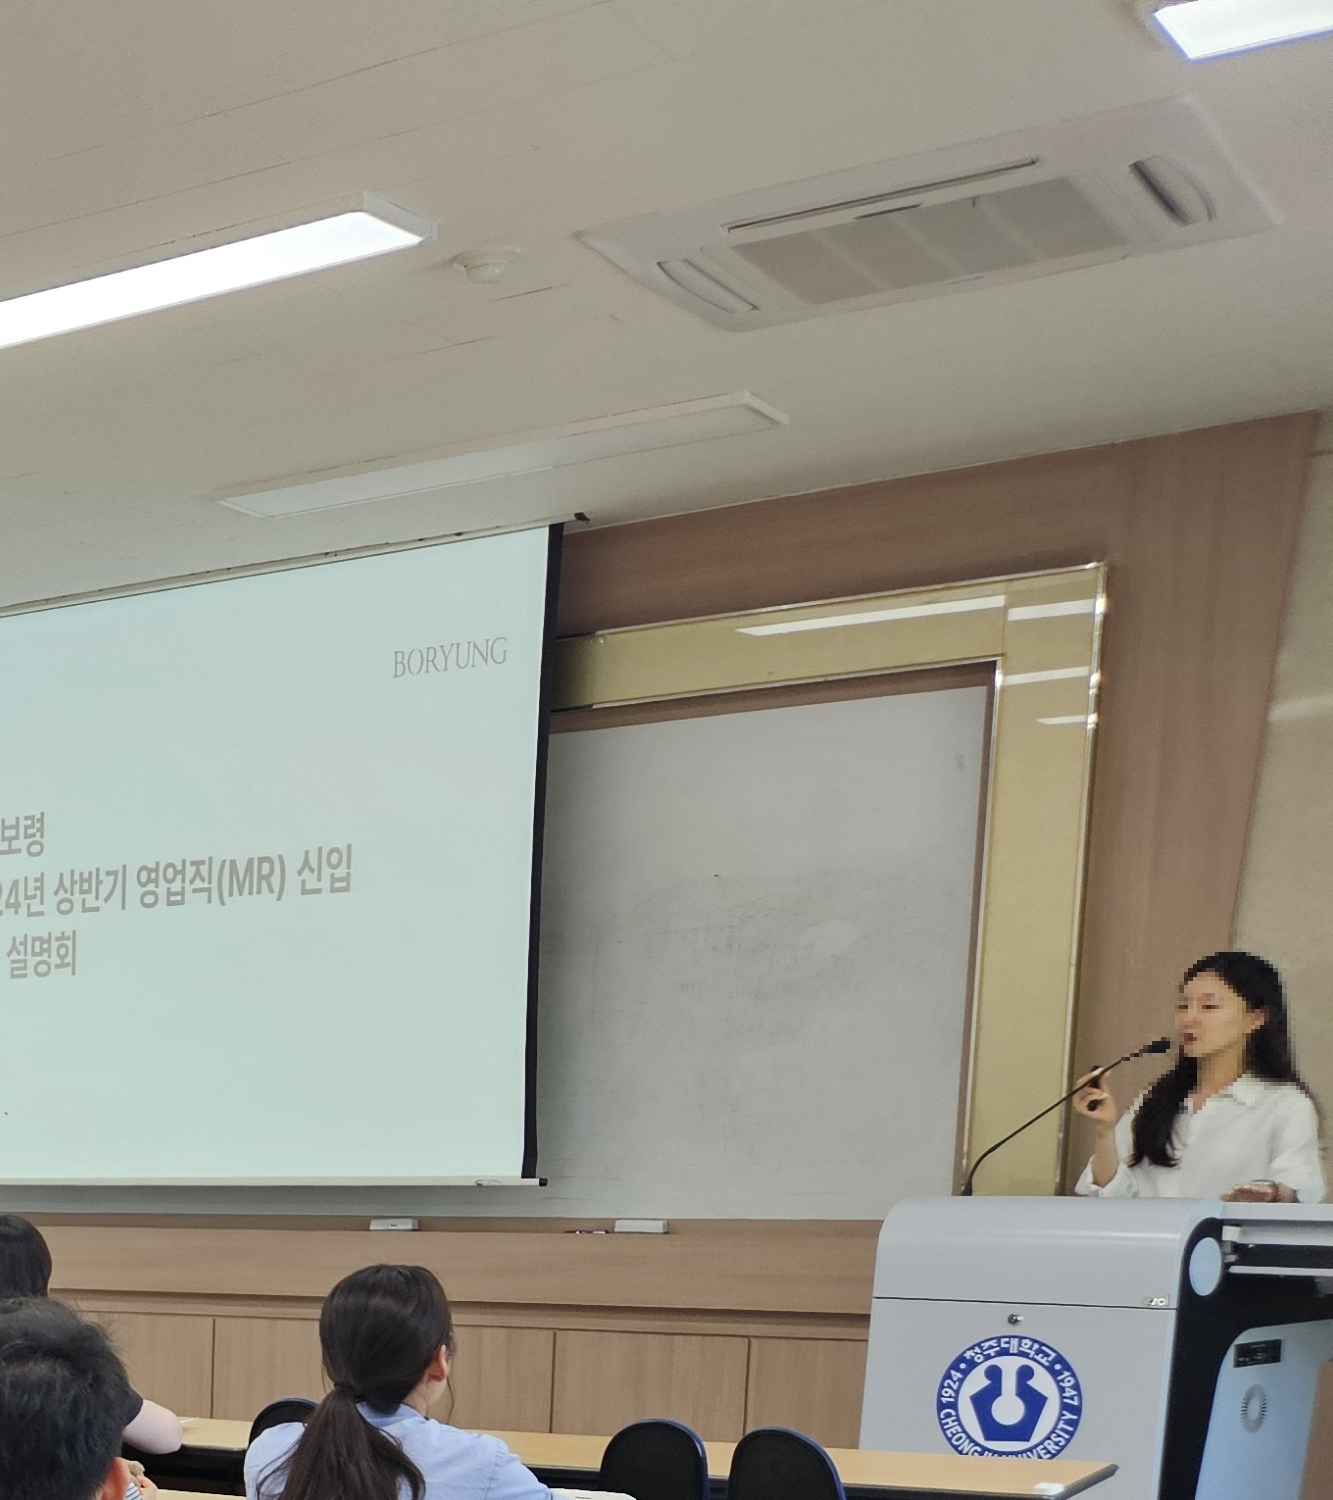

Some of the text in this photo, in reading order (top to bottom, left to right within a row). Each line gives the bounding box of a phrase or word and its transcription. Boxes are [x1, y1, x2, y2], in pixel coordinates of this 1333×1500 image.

[393, 636, 508, 679] BORYUNG
[52, 863, 128, 915] 상반기
[136, 855, 287, 910] 영업직(MR)
[296, 843, 353, 896] 신입
[6, 929, 77, 980] 설명회
[963, 1337, 1058, 1367] 청주대학교
[940, 1369, 963, 1404] 1924
[1056, 1370, 1080, 1406] 1947
[939, 1408, 998, 1457] CHEONG
